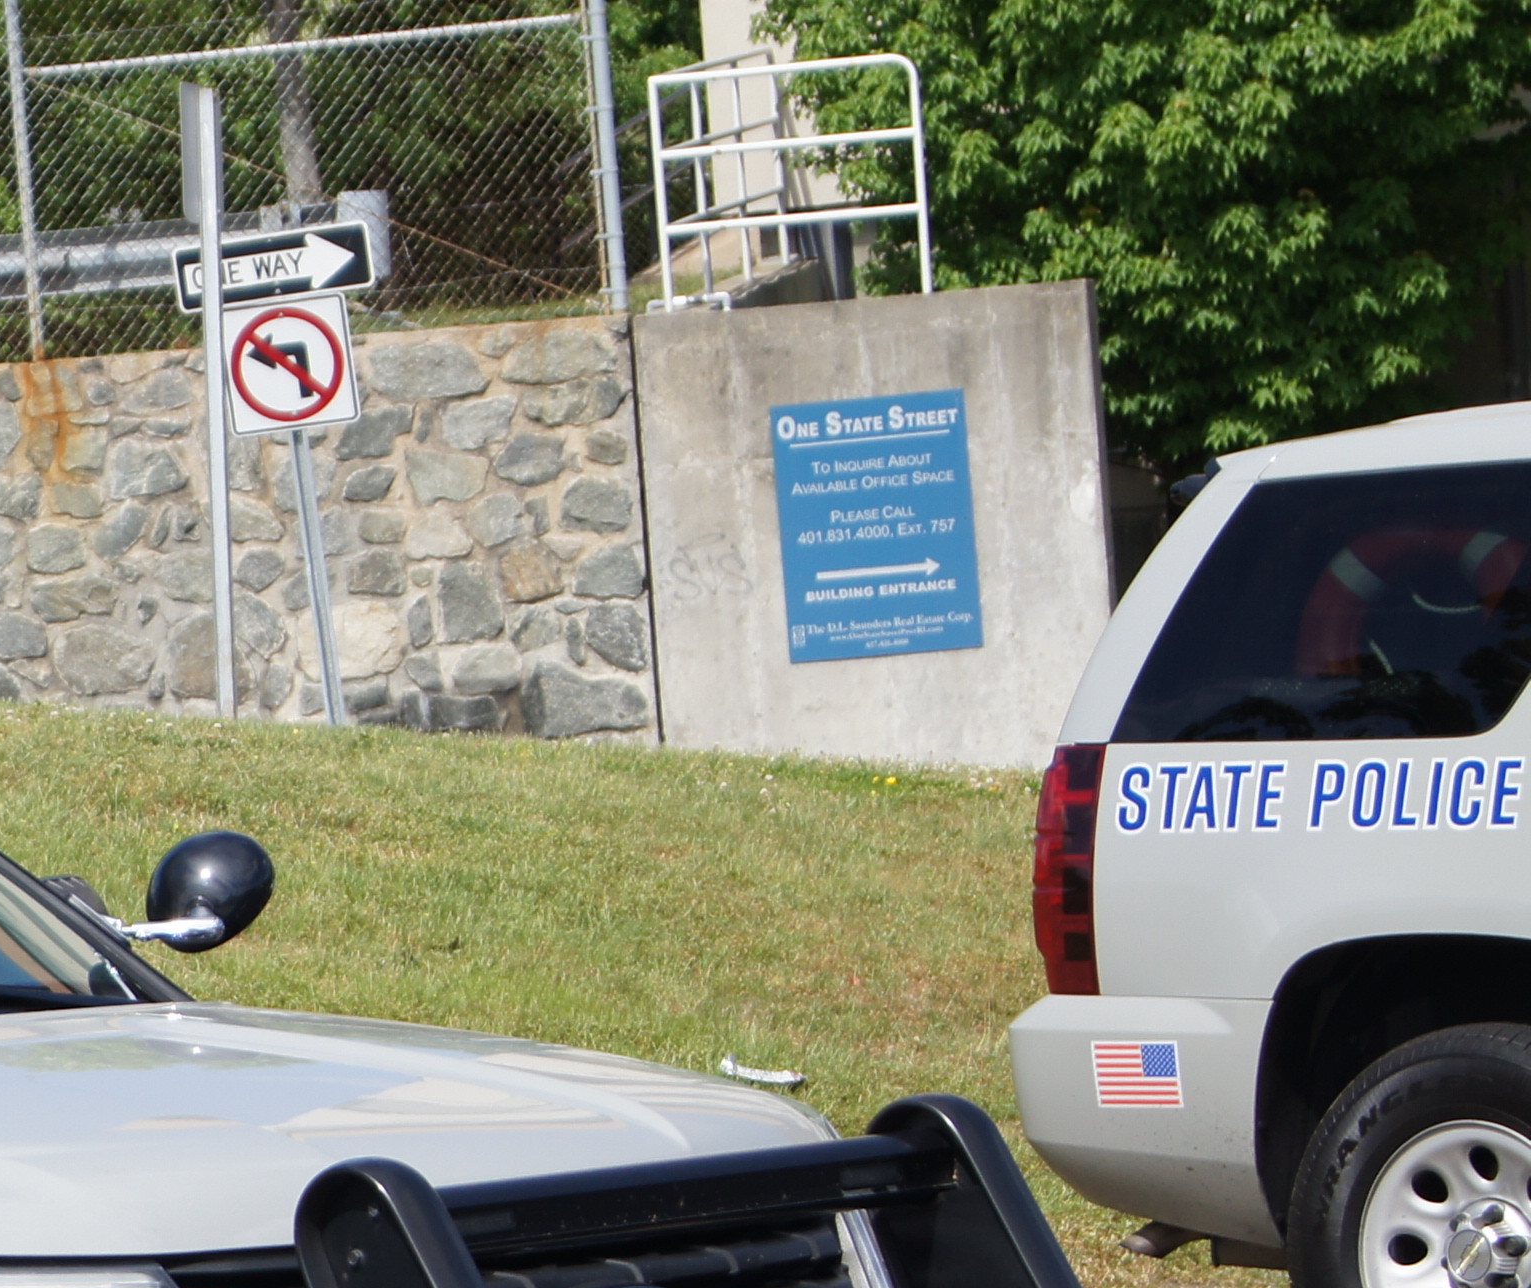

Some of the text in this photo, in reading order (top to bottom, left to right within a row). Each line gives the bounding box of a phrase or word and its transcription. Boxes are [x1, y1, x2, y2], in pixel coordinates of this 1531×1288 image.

[192, 250, 304, 289] OE WAY
[777, 405, 958, 440] ONE STATE STREET
[811, 453, 932, 474] TO INQUIRE ABOUT
[791, 470, 955, 495] AVAILABLE OFFICE SPACE
[830, 505, 916, 523] PLEASE CALL
[931, 518, 956, 533] 757
[805, 578, 957, 603] BUILDING ENTRANCE
[806, 623, 825, 634] The
[894, 614, 915, 626] Real
[1116, 757, 1526, 835] STATE POLICE
